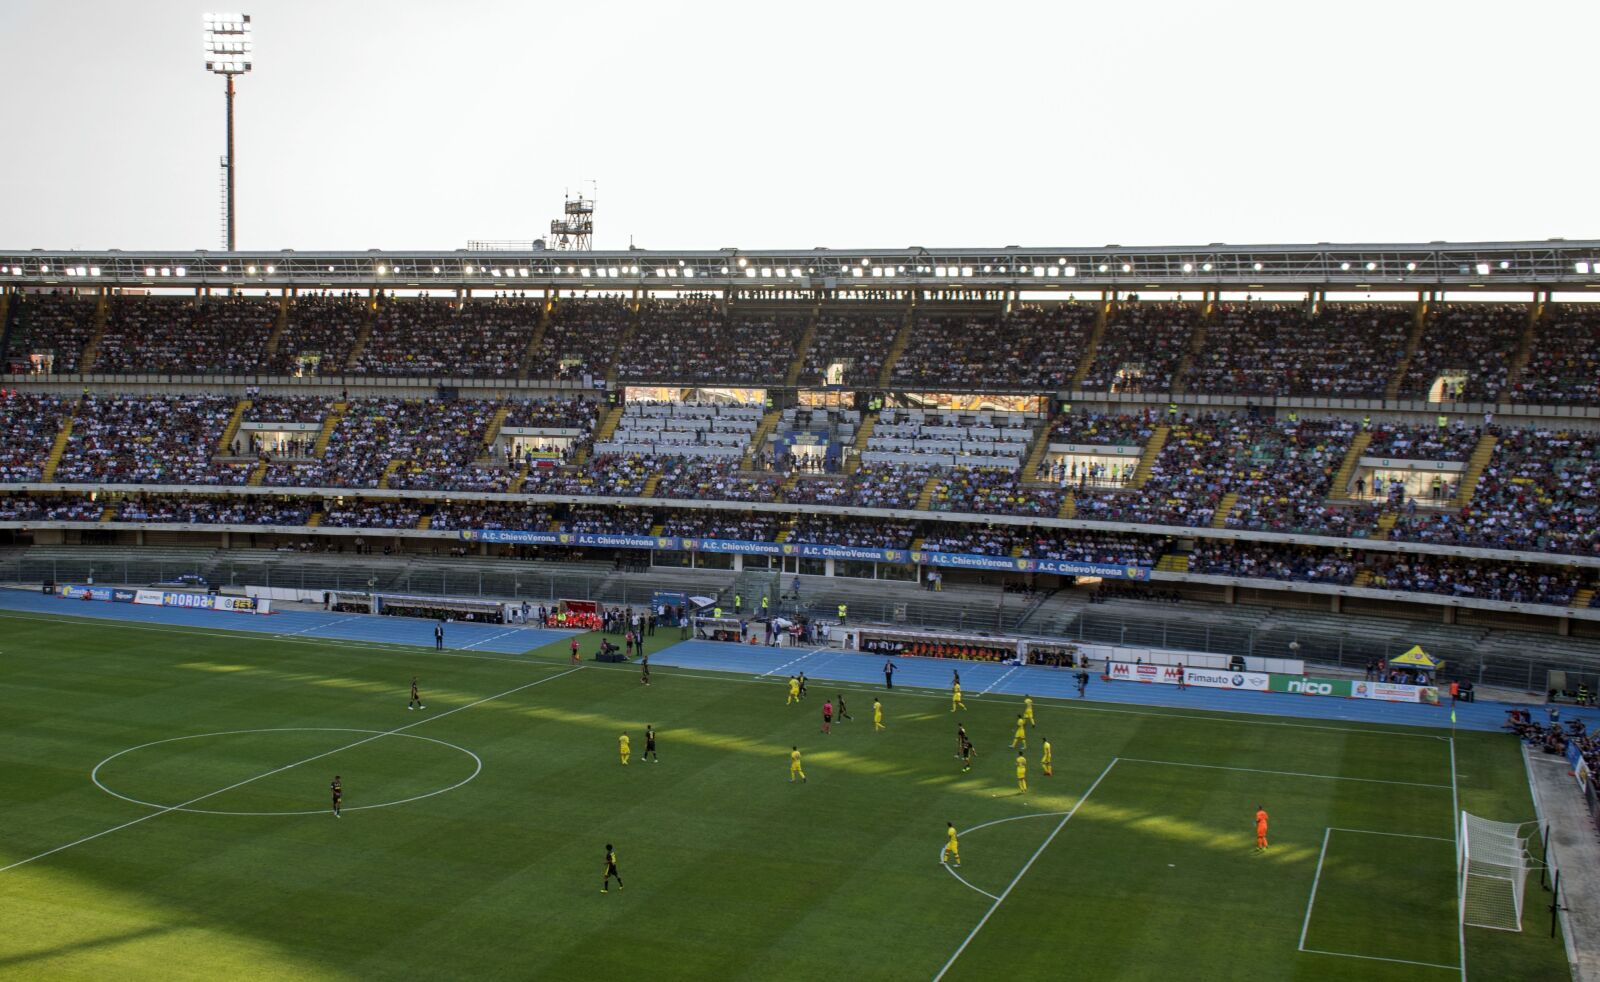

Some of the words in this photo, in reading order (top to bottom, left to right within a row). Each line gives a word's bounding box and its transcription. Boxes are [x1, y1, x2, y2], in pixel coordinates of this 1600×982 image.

[482, 532, 498, 540] A.C.
[500, 533, 556, 542] ChievoVerona
[579, 535, 596, 543] A.C.
[597, 536, 654, 546] ChievoVerona
[703, 541, 720, 549] A.C.
[721, 542, 779, 553] ChievoVerona
[803, 546, 821, 555] A.C.
[822, 547, 881, 559] ChievoVerona
[932, 555, 950, 563] A.C.
[951, 556, 1013, 568] ChievoVerona
[1038, 562, 1057, 571] A.C.
[1058, 563, 1122, 576] ChievoVerona
[1187, 672, 1229, 684] Fimauto
[1287, 677, 1332, 695] nico
